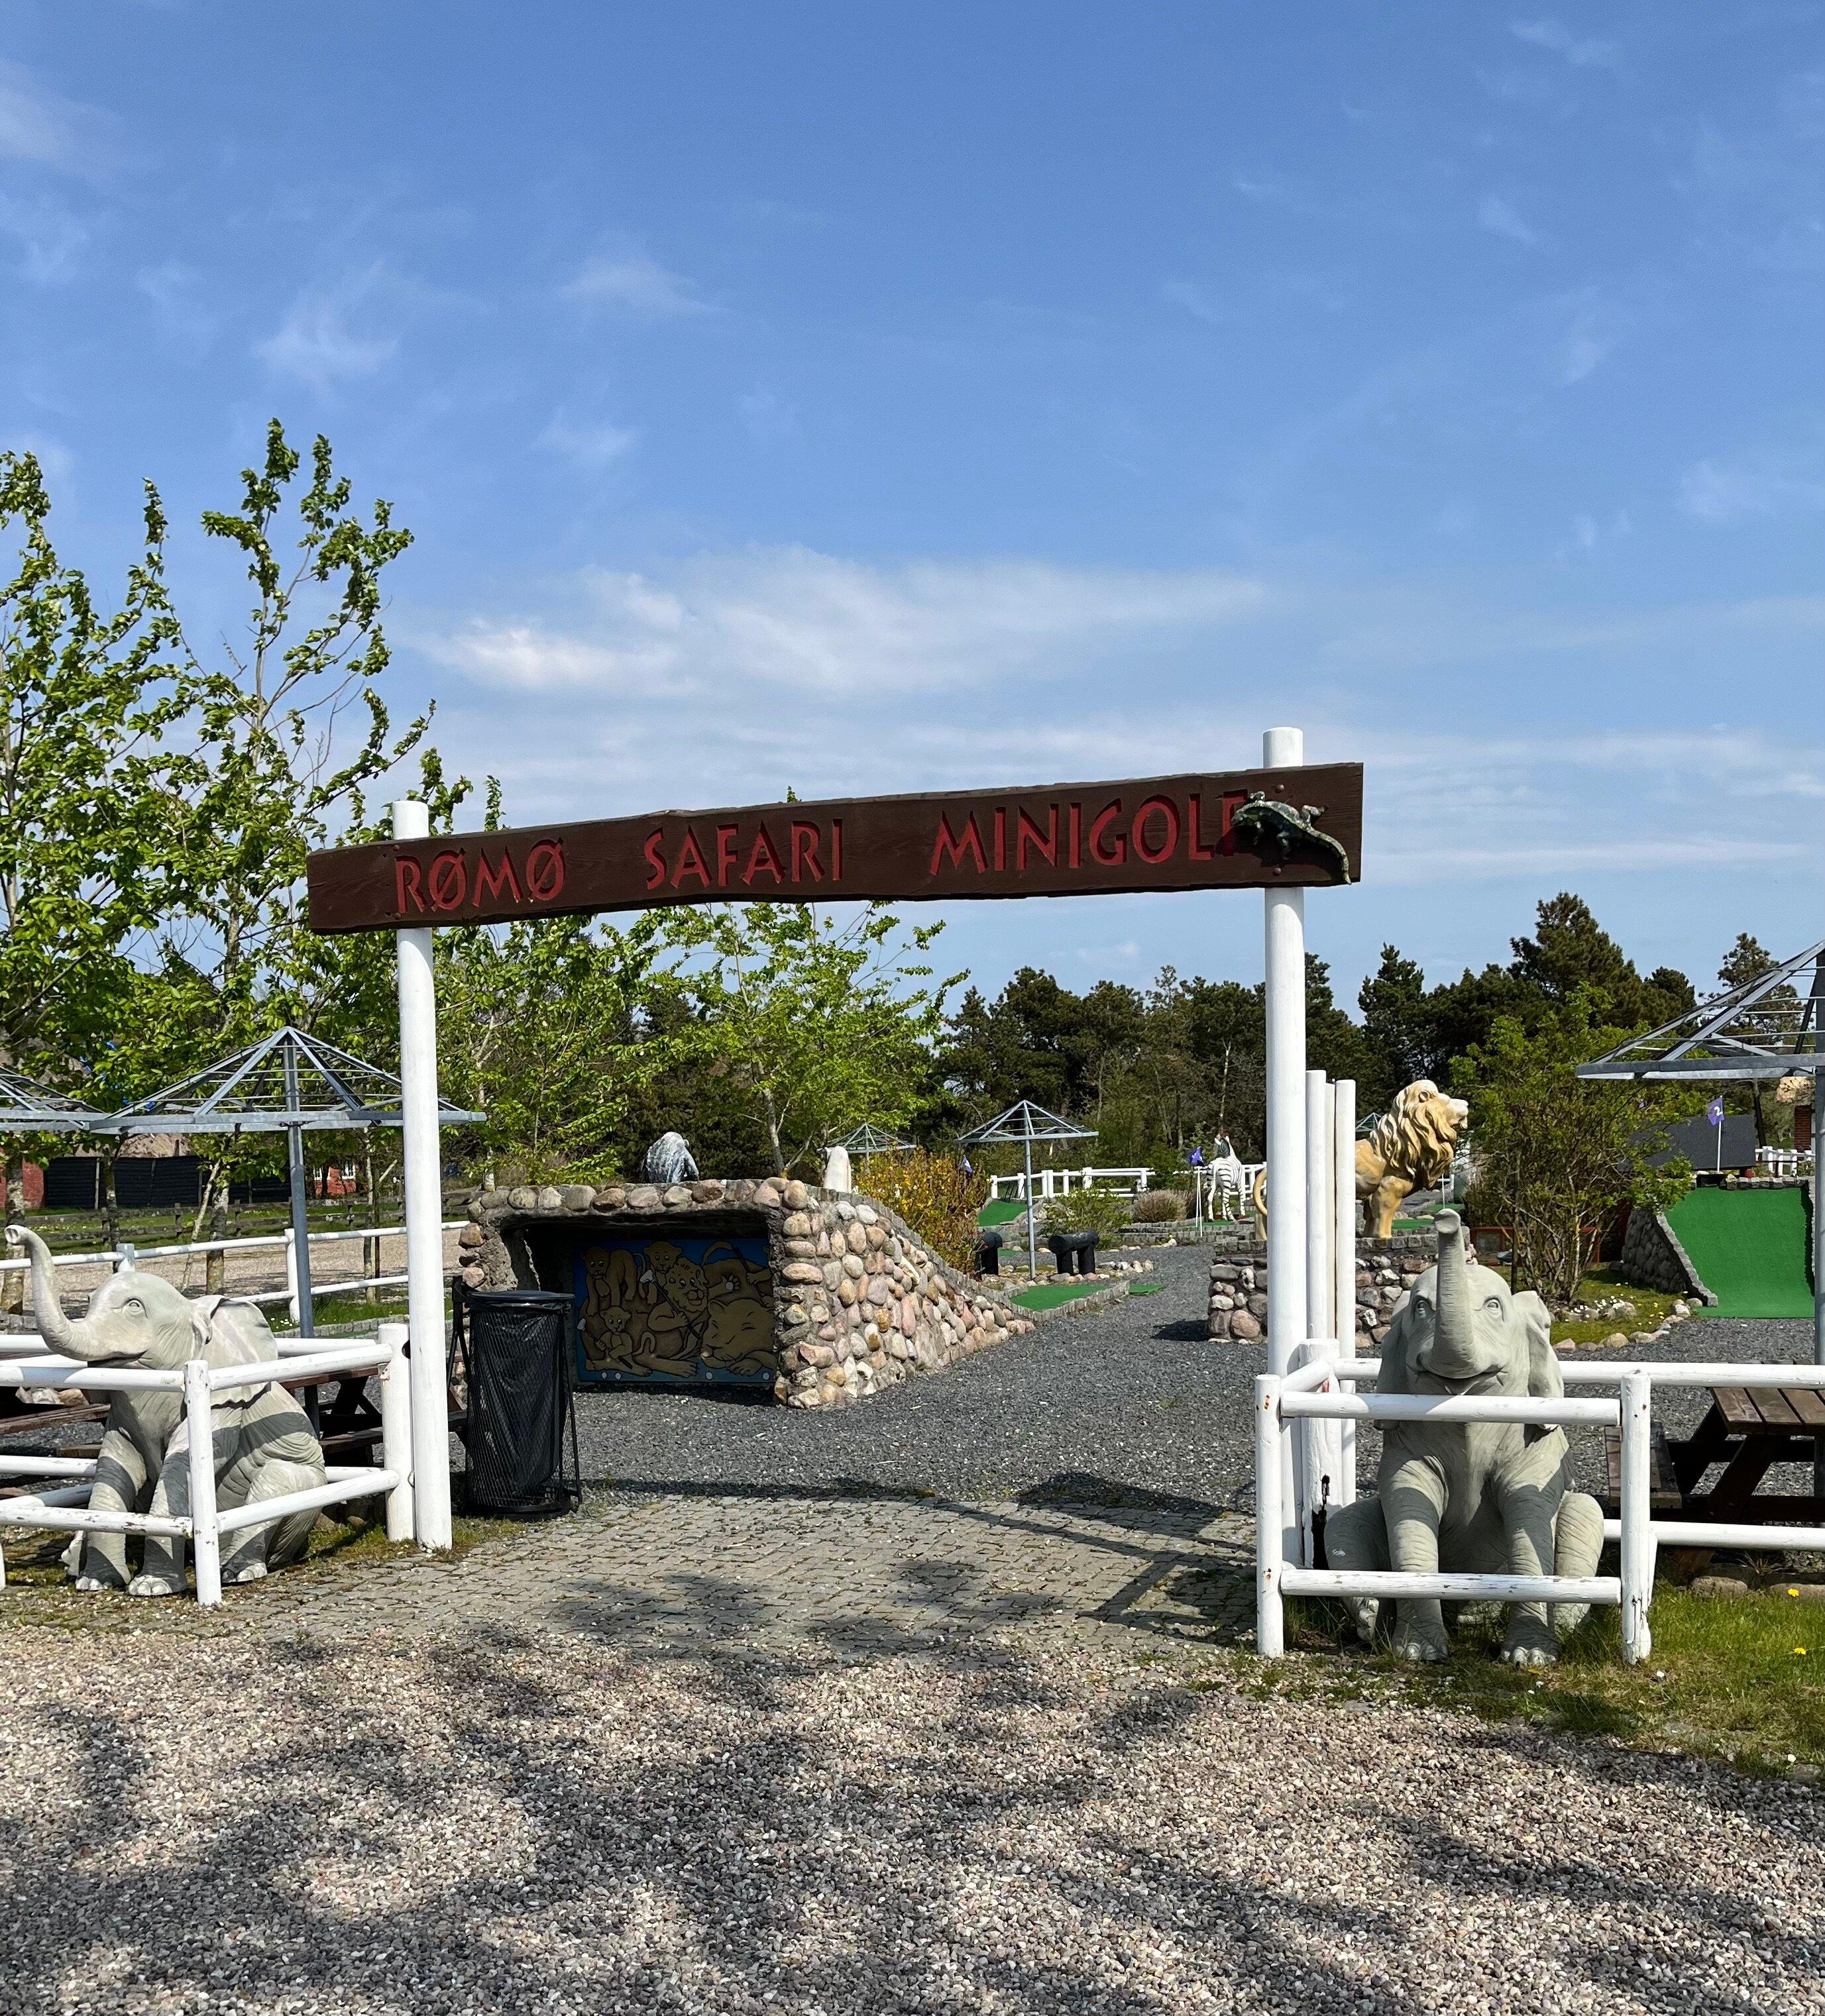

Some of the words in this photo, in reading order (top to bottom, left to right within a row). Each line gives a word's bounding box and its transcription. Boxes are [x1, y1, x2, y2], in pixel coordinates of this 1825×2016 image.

[395, 838, 566, 914] RØMØ
[644, 819, 843, 890] SAFARI
[1714, 1106, 1723, 1116] 2
